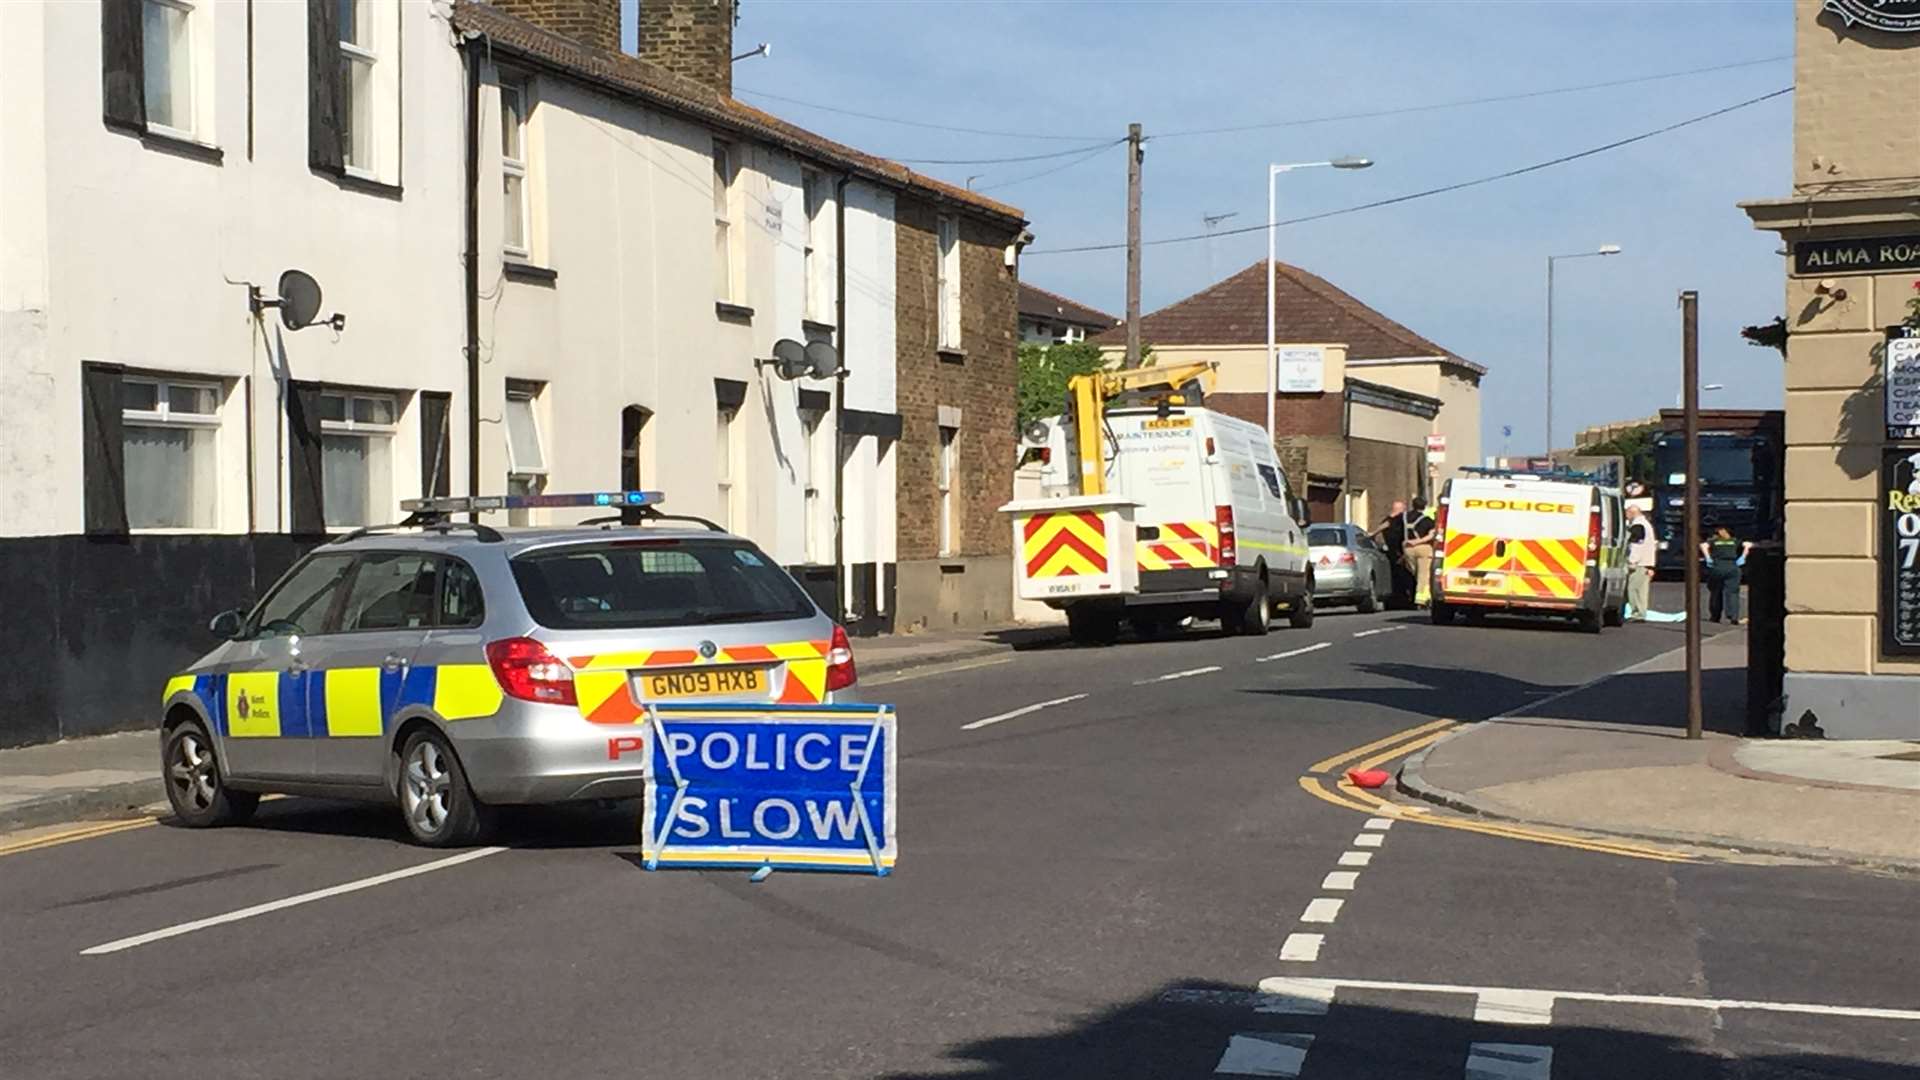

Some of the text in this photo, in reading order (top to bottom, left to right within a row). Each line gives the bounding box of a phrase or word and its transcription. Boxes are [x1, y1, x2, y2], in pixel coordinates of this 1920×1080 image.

[1806, 247, 1872, 266] ALMA
[1464, 499, 1575, 514] POLICE
[652, 669, 758, 695] GN09 HXB
[668, 731, 868, 771] POLICE
[674, 796, 866, 841] SLOW
